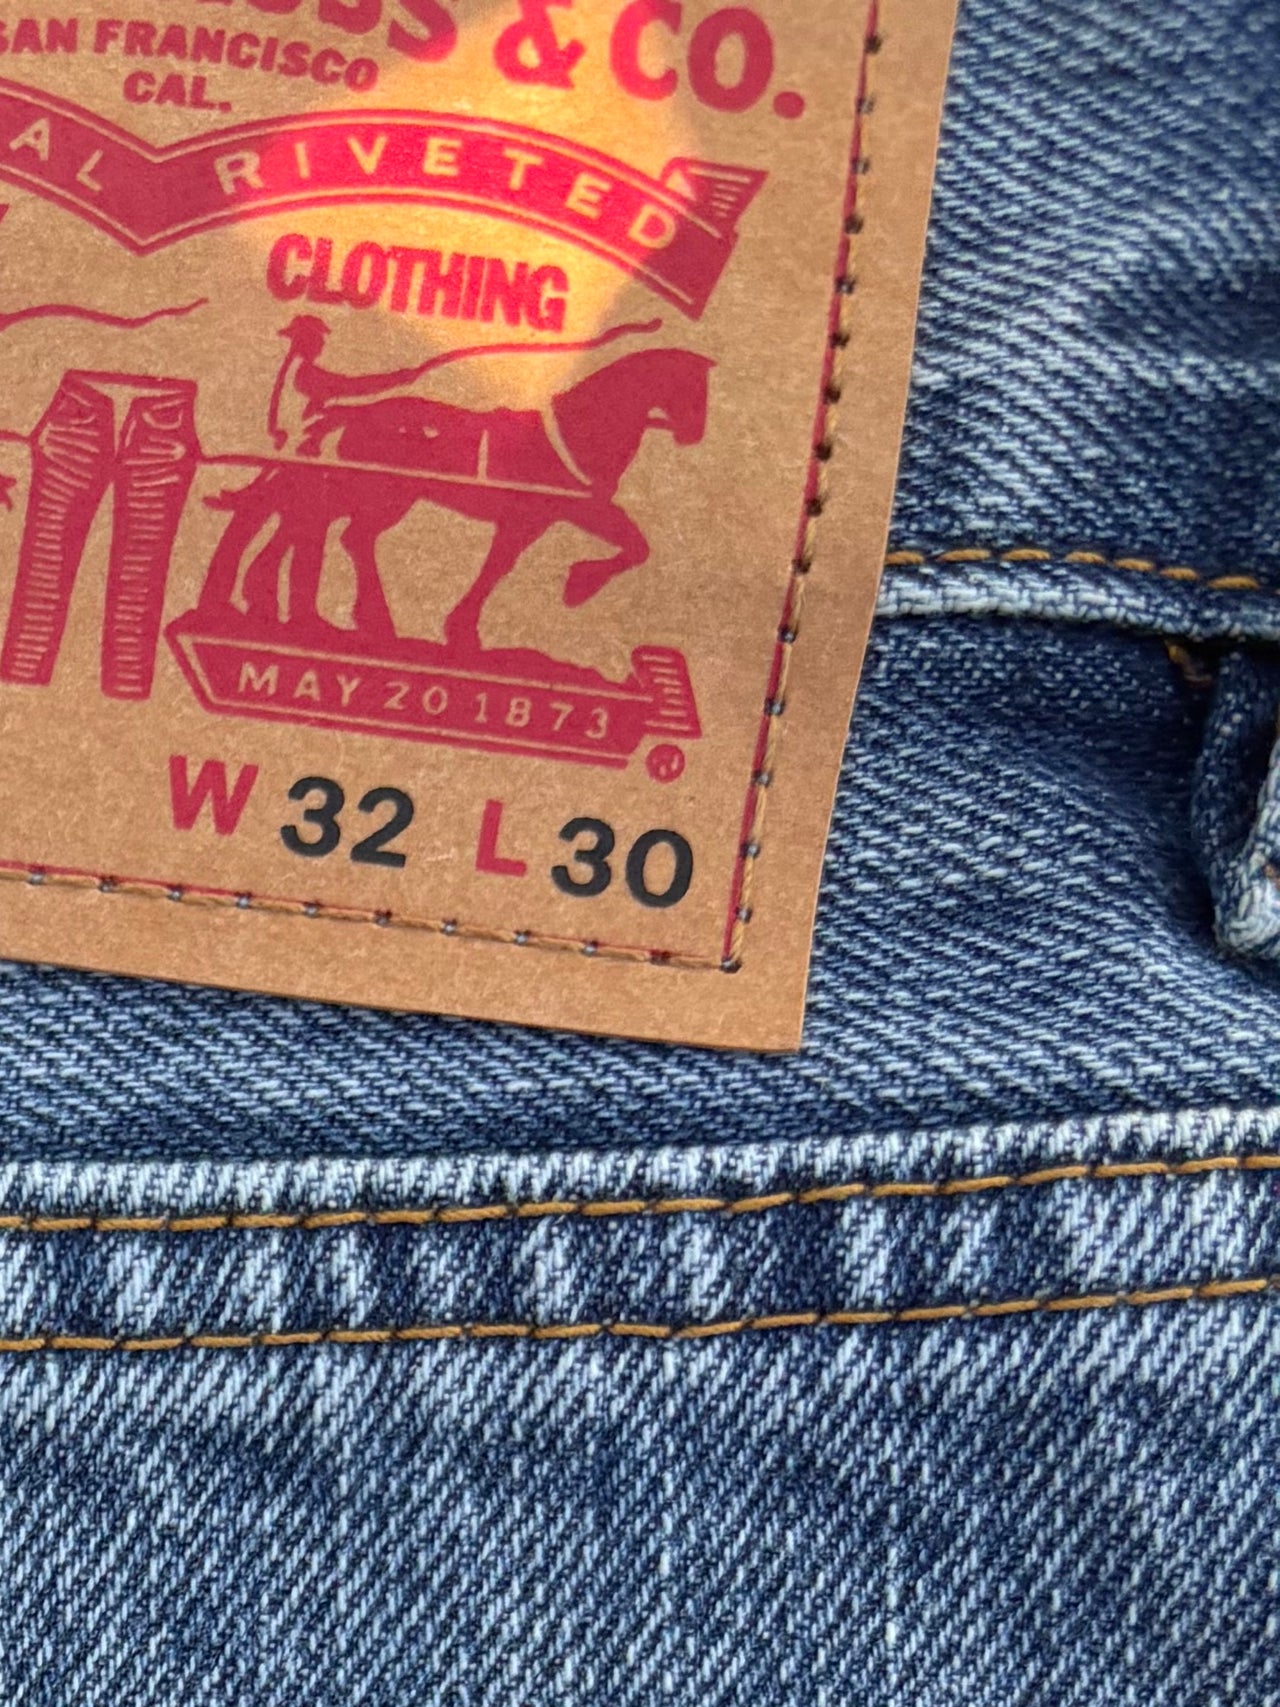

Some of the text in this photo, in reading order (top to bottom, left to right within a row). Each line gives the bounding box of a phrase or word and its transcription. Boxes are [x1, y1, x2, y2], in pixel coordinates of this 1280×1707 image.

[93, 18, 380, 93] FRANCISCO
[122, 71, 233, 112] CAL.
[610, 0, 805, 119] CO.
[214, 135, 676, 249] RIVETED
[266, 232, 570, 333] CLOTHING
[238, 661, 610, 739] MAY 20 1873
[169, 754, 694, 908] W 32 L 30
